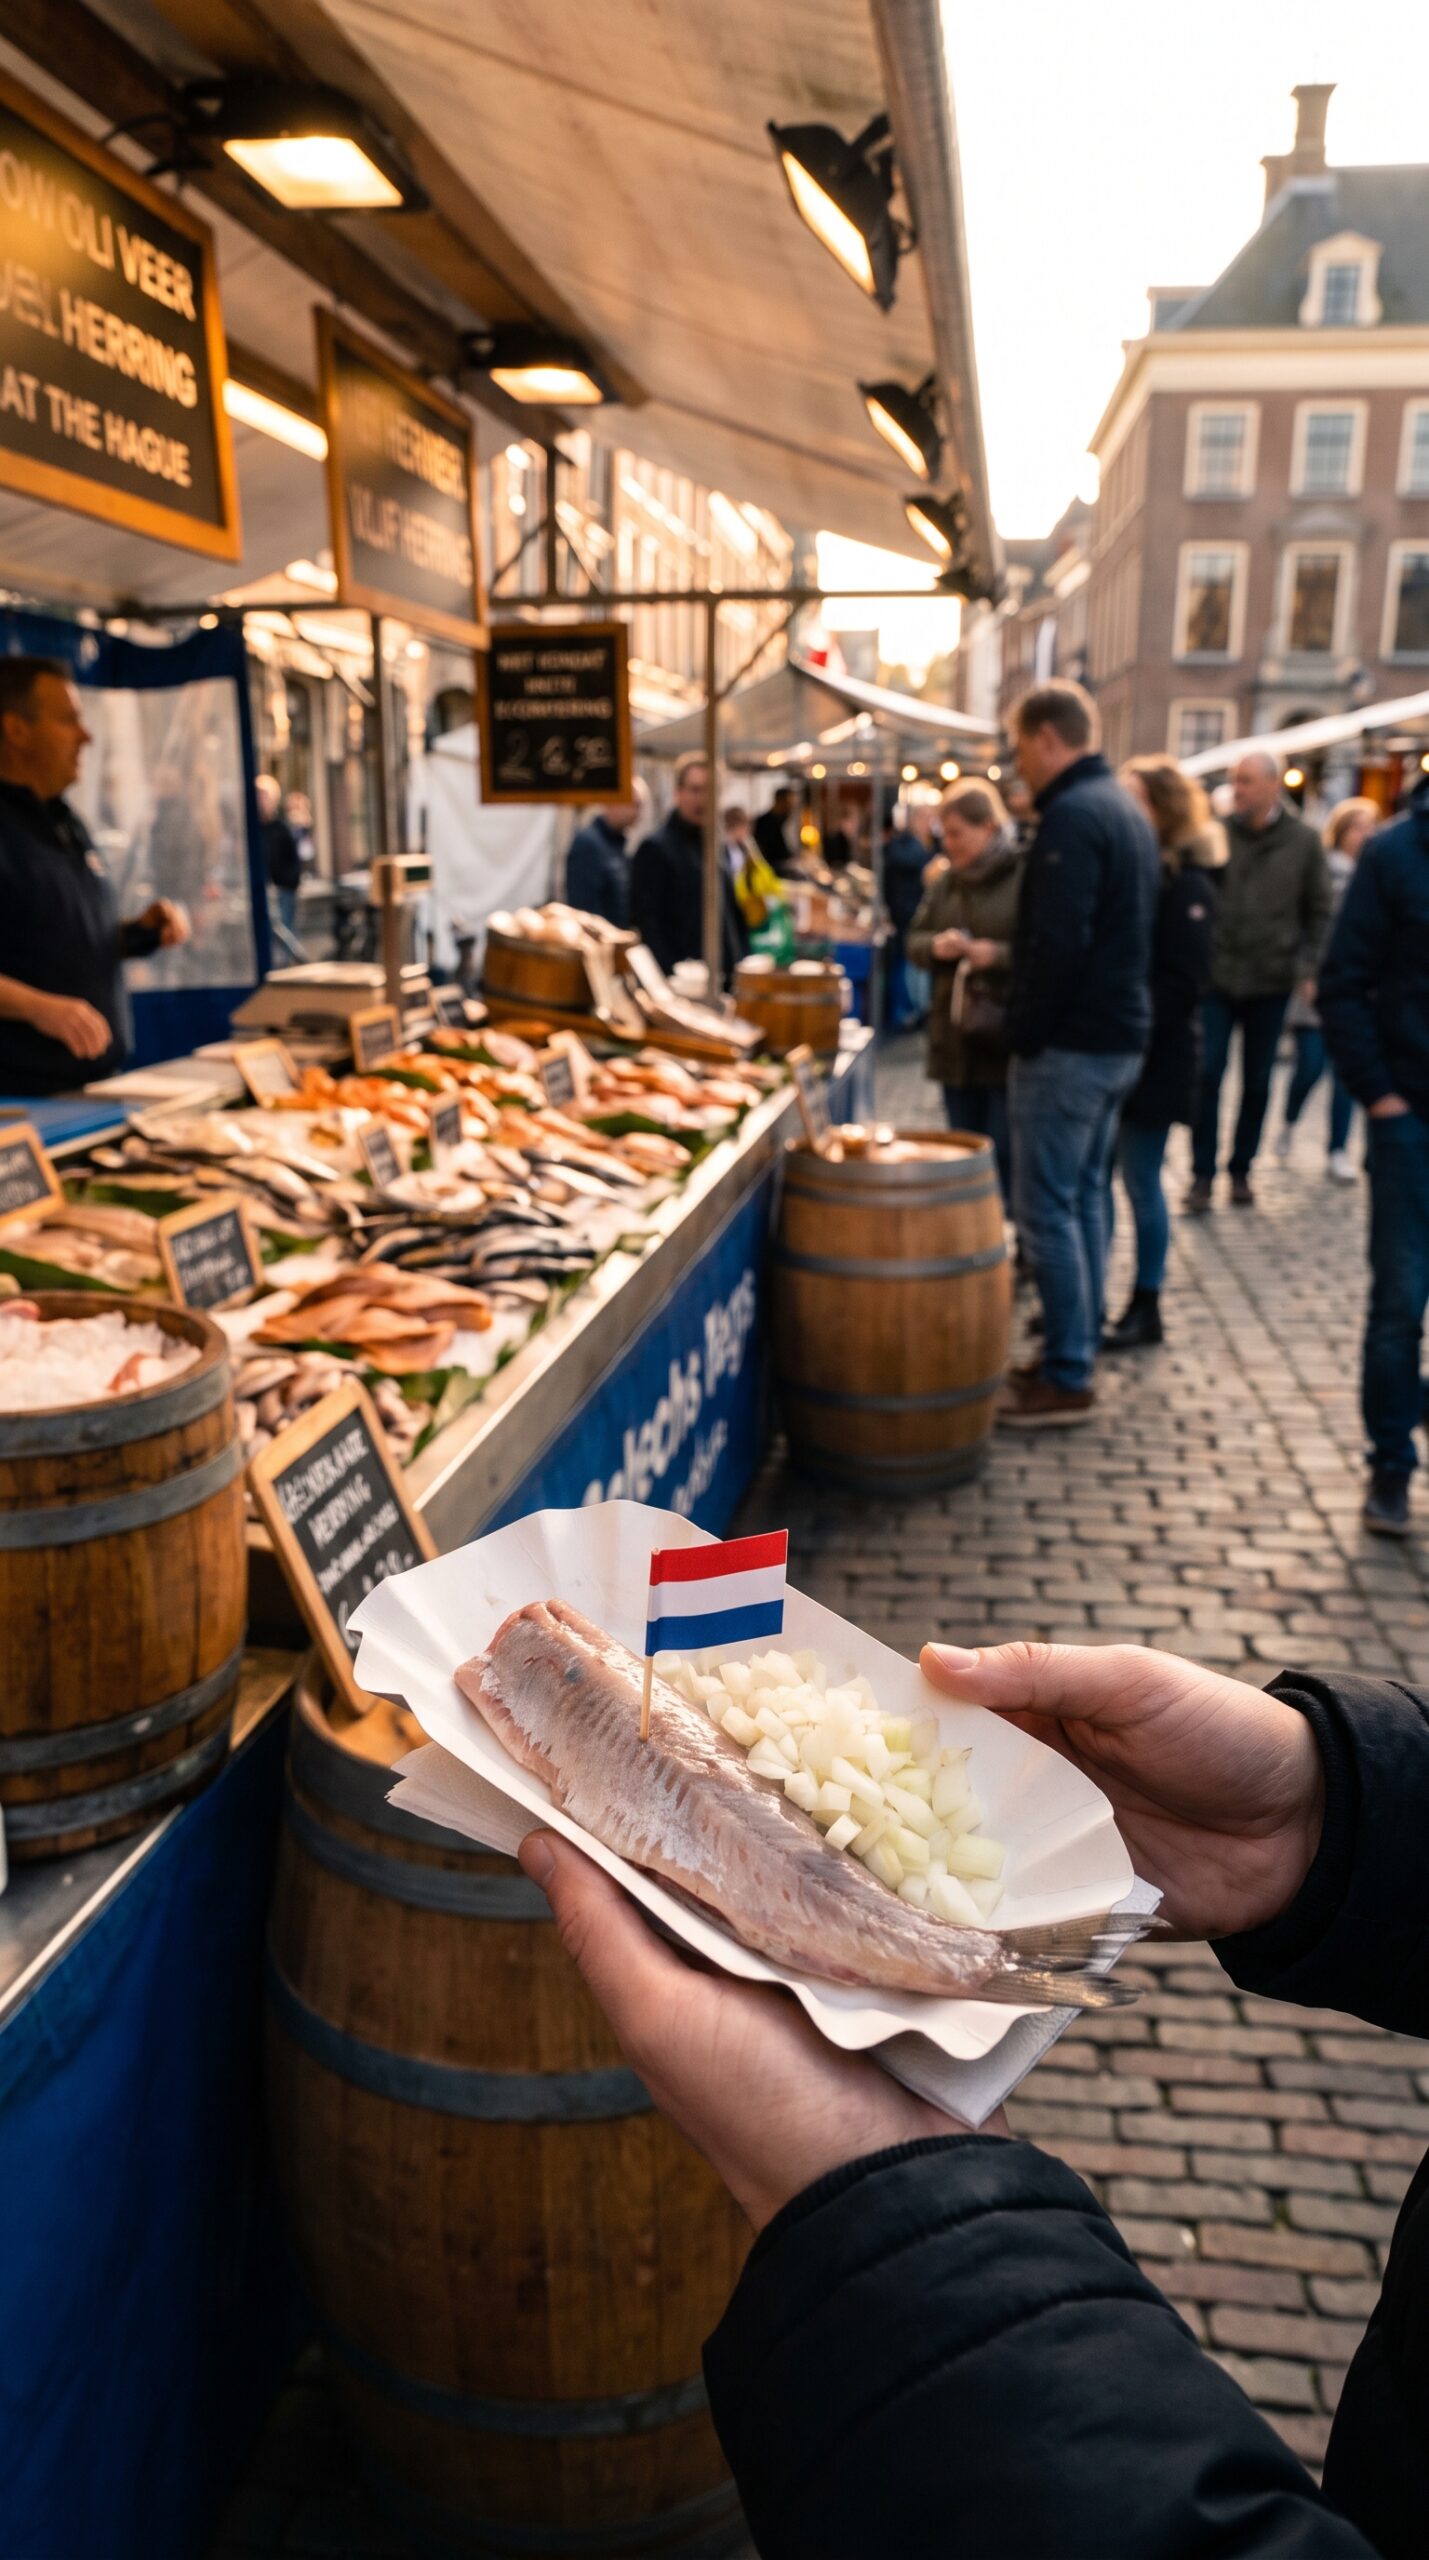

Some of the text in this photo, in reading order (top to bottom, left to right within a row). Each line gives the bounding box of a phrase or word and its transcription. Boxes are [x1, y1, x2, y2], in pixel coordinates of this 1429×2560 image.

[59, 287, 198, 409] HERRING
[43, 383, 103, 451] THE
[102, 409, 192, 488] HAGUE
